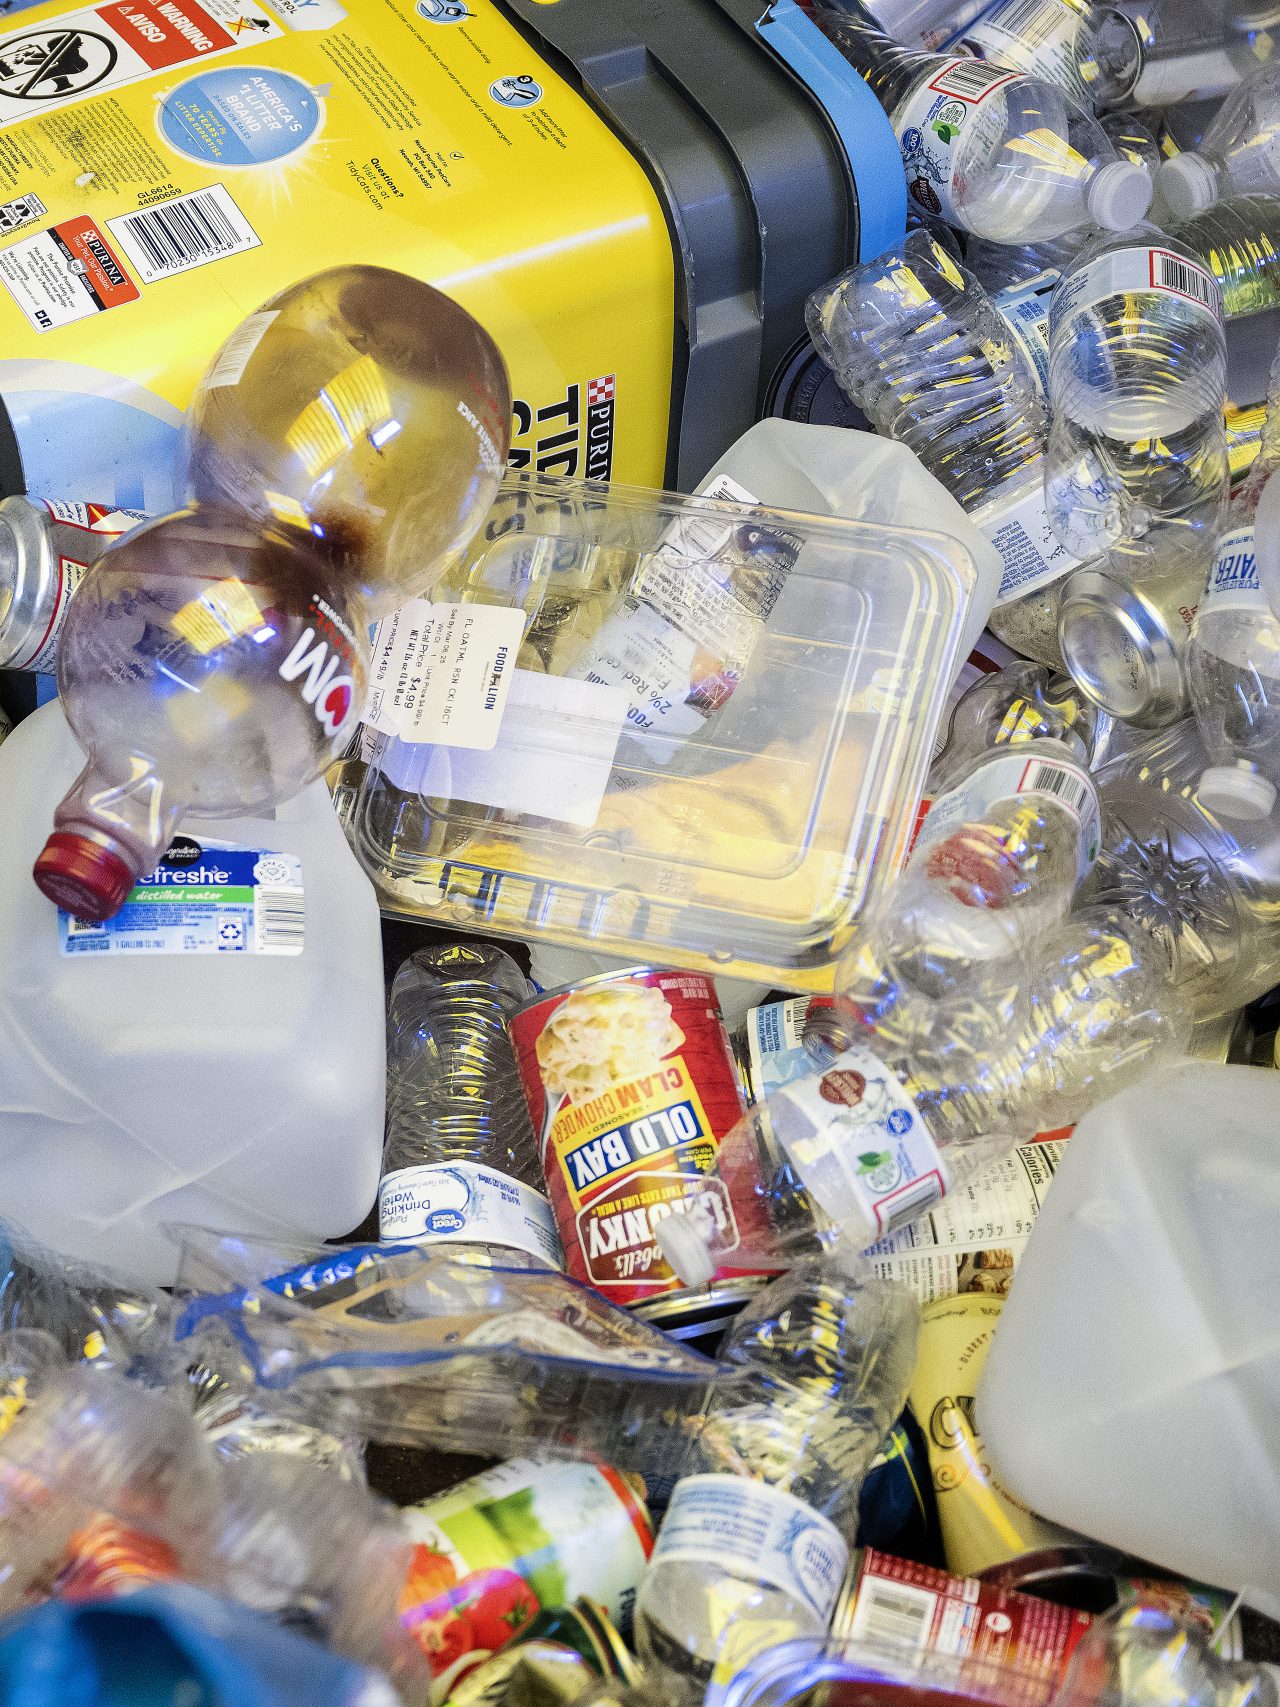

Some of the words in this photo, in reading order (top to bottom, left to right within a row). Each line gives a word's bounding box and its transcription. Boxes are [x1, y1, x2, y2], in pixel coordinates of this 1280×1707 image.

[124, 10, 167, 43] AVISO
[156, 0, 214, 52] WARNING
[224, 93, 263, 132] BRAND
[244, 93, 283, 131] LITTER
[249, 75, 304, 132] AMERICA'S
[173, 100, 196, 122] LITTER
[191, 122, 224, 157] EXPERTISE
[188, 103, 201, 113] 70
[196, 113, 221, 138] YEARS
[212, 94, 231, 112] BASED
[226, 112, 238, 121] ON
[233, 121, 253, 139] SALES
[418, 160, 428, 168] Box
[424, 153, 439, 168] Purina
[435, 168, 453, 187] PetCare
[342, 160, 386, 210] TidyCats.com
[359, 163, 377, 180] Visit
[372, 181, 383, 190] us
[379, 190, 391, 199] at
[368, 157, 405, 198] Questions?
[136, 187, 181, 207] 44090659
[137, 182, 173, 199] GL6614
[71, 235, 84, 248] Your
[79, 247, 92, 258] Pet.
[86, 257, 98, 268] Our
[93, 268, 112, 290] Passion.
[88, 240, 123, 284] PURINA
[164, 255, 195, 271] 70230
[203, 242, 233, 258] 15348
[36, 266, 51, 283] Progress
[46, 253, 55, 261] The
[51, 261, 64, 275] Purina
[61, 275, 76, 294] Promise
[56, 283, 68, 296] Safety
[587, 405, 610, 483] PURIN
[392, 613, 400, 626] UNIT
[422, 618, 434, 642] Total
[464, 618, 473, 628] FL
[387, 628, 397, 645] PRICE
[407, 642, 415, 650] WT
[409, 629, 418, 640] NET
[404, 653, 412, 661] 16
[415, 644, 429, 667] Price
[439, 655, 445, 663] 25
[456, 632, 469, 663] OATML
[493, 646, 507, 672] FOOD
[401, 662, 408, 670] oz
[424, 668, 432, 680] Unit
[451, 667, 460, 683] RSN
[404, 676, 421, 709] $4.99
[420, 682, 429, 697] Price
[484, 687, 497, 710] LION
[139, 865, 228, 885] efreshe
[135, 887, 184, 902] distilled
[185, 889, 222, 900] water
[614, 1066, 682, 1107] CLAM
[550, 1092, 614, 1145] CHOWDER
[591, 1104, 642, 1131] SEASONED
[628, 1103, 698, 1156] OLD
[570, 1128, 631, 1184] BAY
[1020, 1145, 1044, 1184] Calories
[595, 1199, 615, 1216] MEAL
[621, 1193, 638, 1207] LIKE
[639, 1188, 662, 1203] EATS
[381, 1198, 430, 1218] Drinking
[431, 1213, 455, 1221] Value
[431, 1219, 461, 1228] Great
